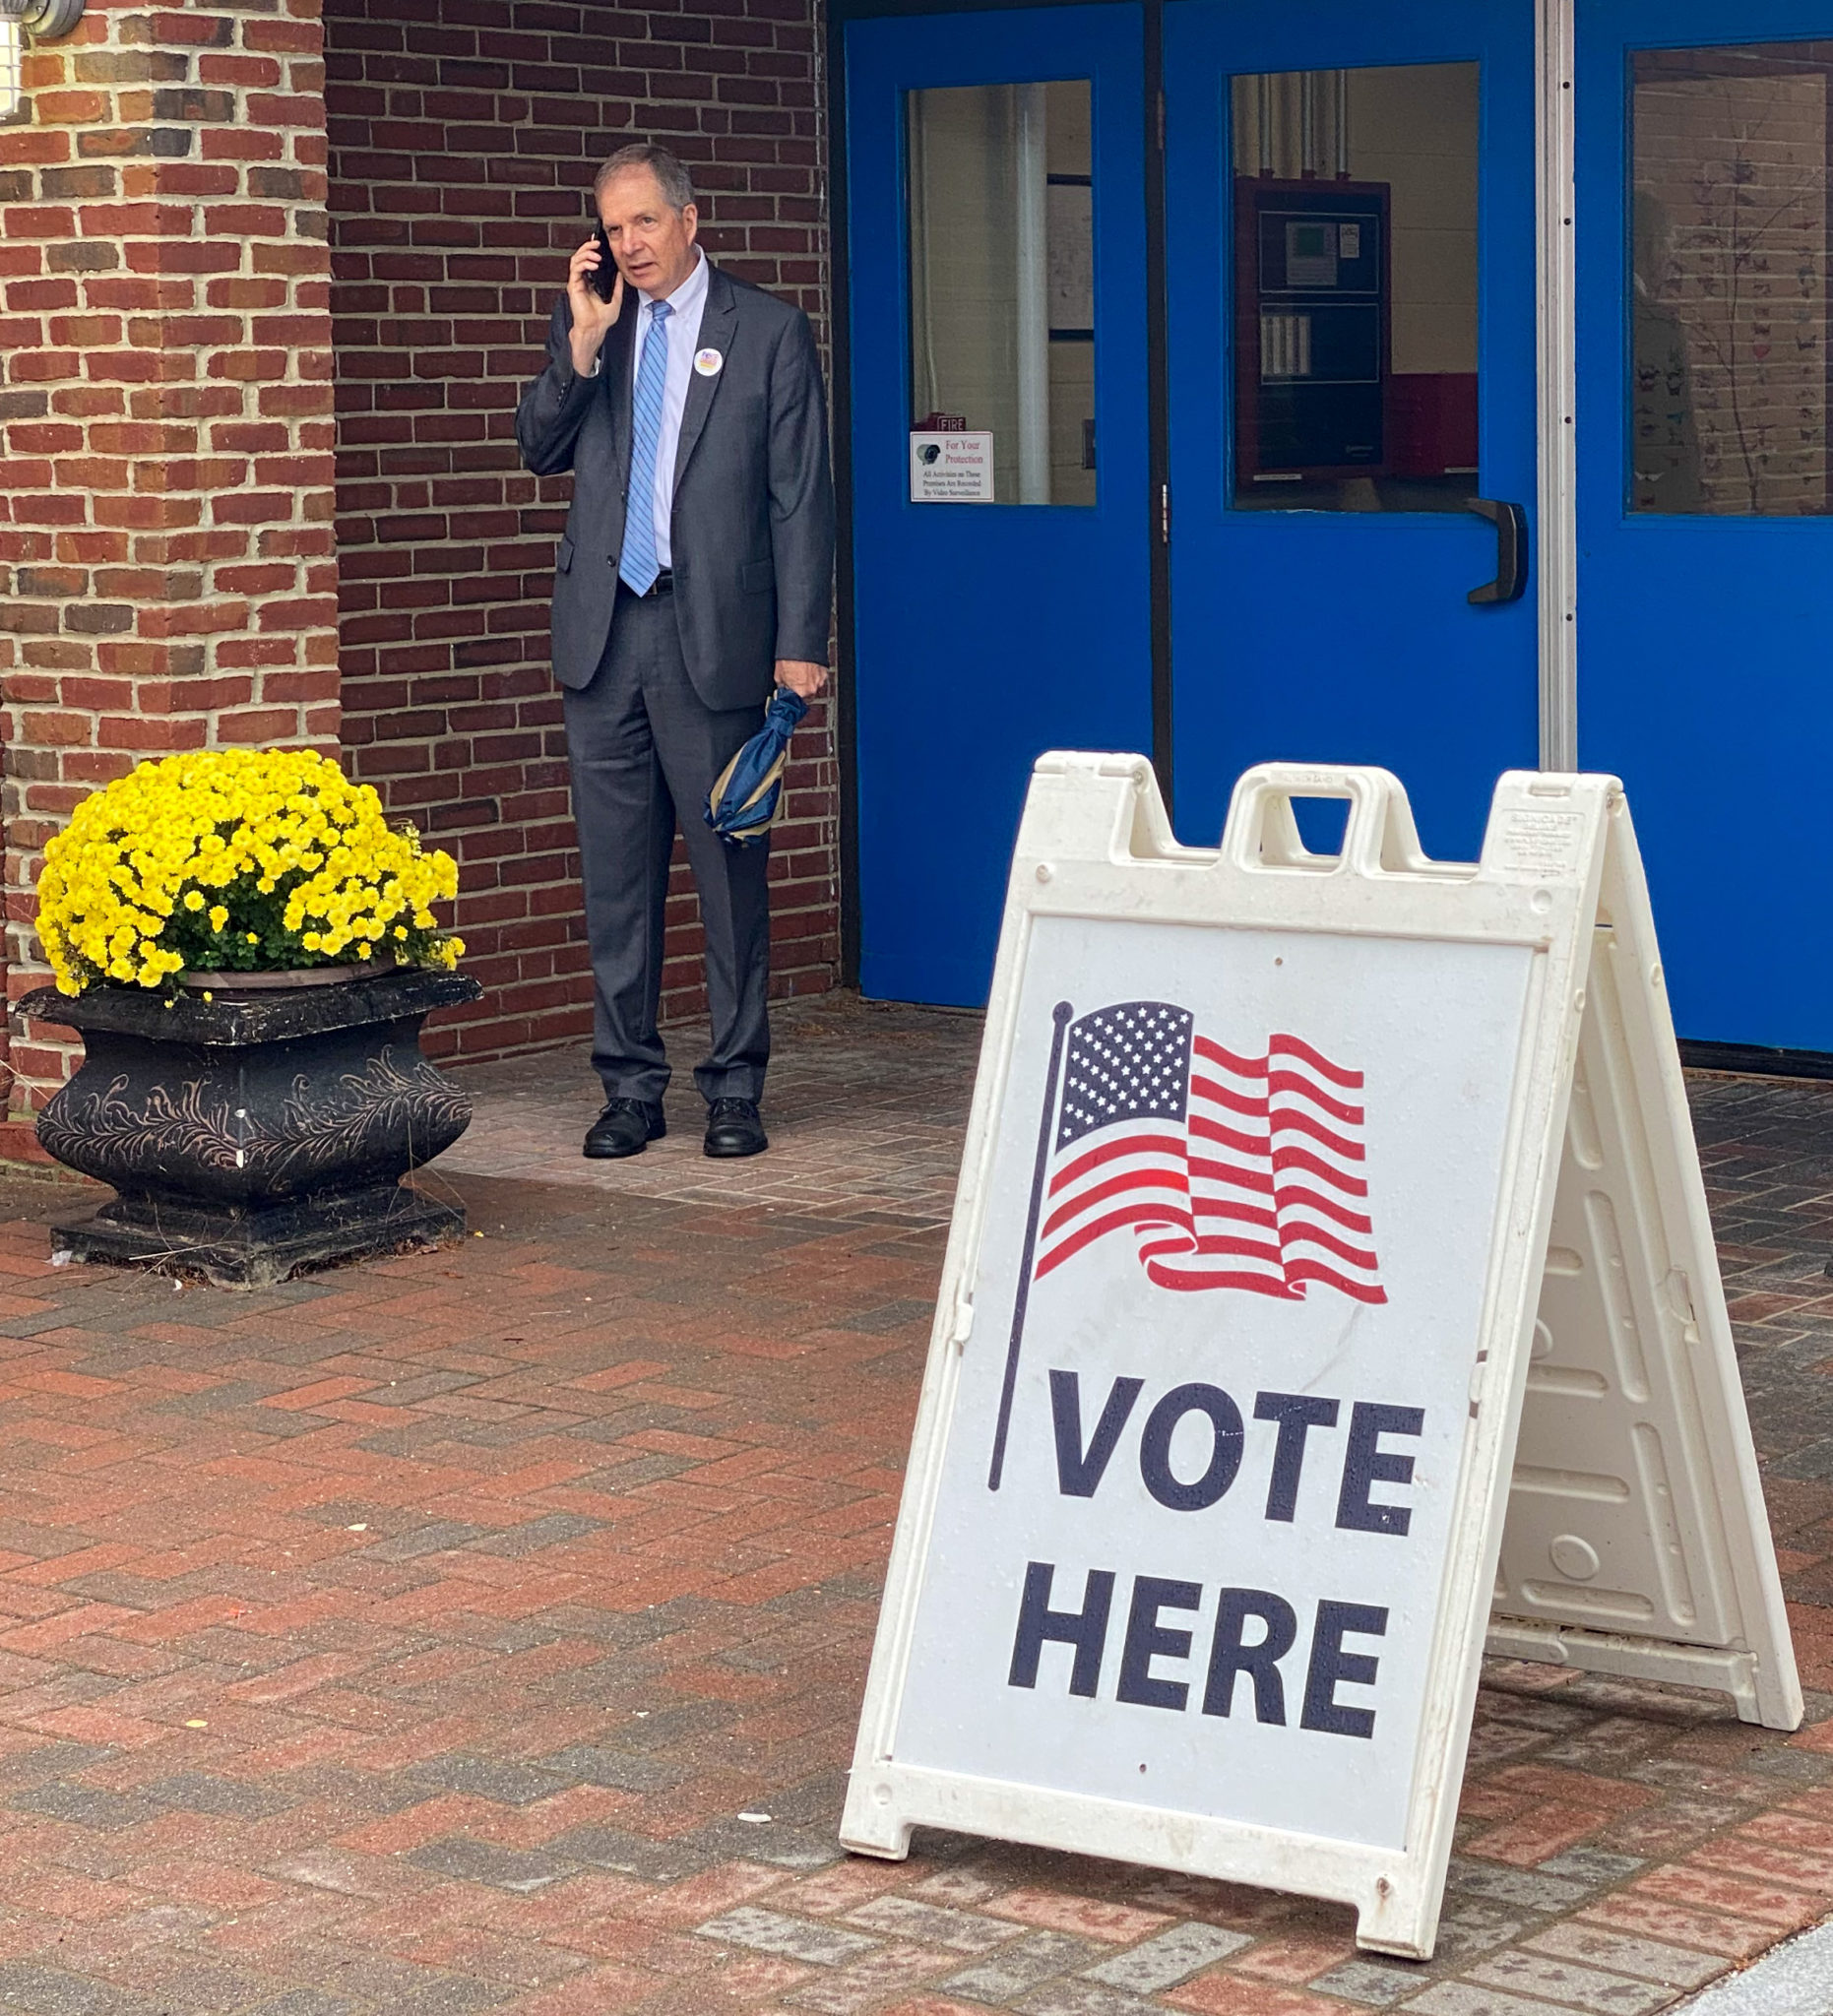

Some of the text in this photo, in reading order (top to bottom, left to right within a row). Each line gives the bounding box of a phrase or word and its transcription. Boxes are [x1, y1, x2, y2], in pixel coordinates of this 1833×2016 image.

[941, 418, 964, 431] FIRE
[945, 440, 980, 450] For Your
[945, 454, 983, 464] Protection
[1048, 1369, 1426, 1537] VOTE
[1007, 1561, 1390, 1739] HERE
